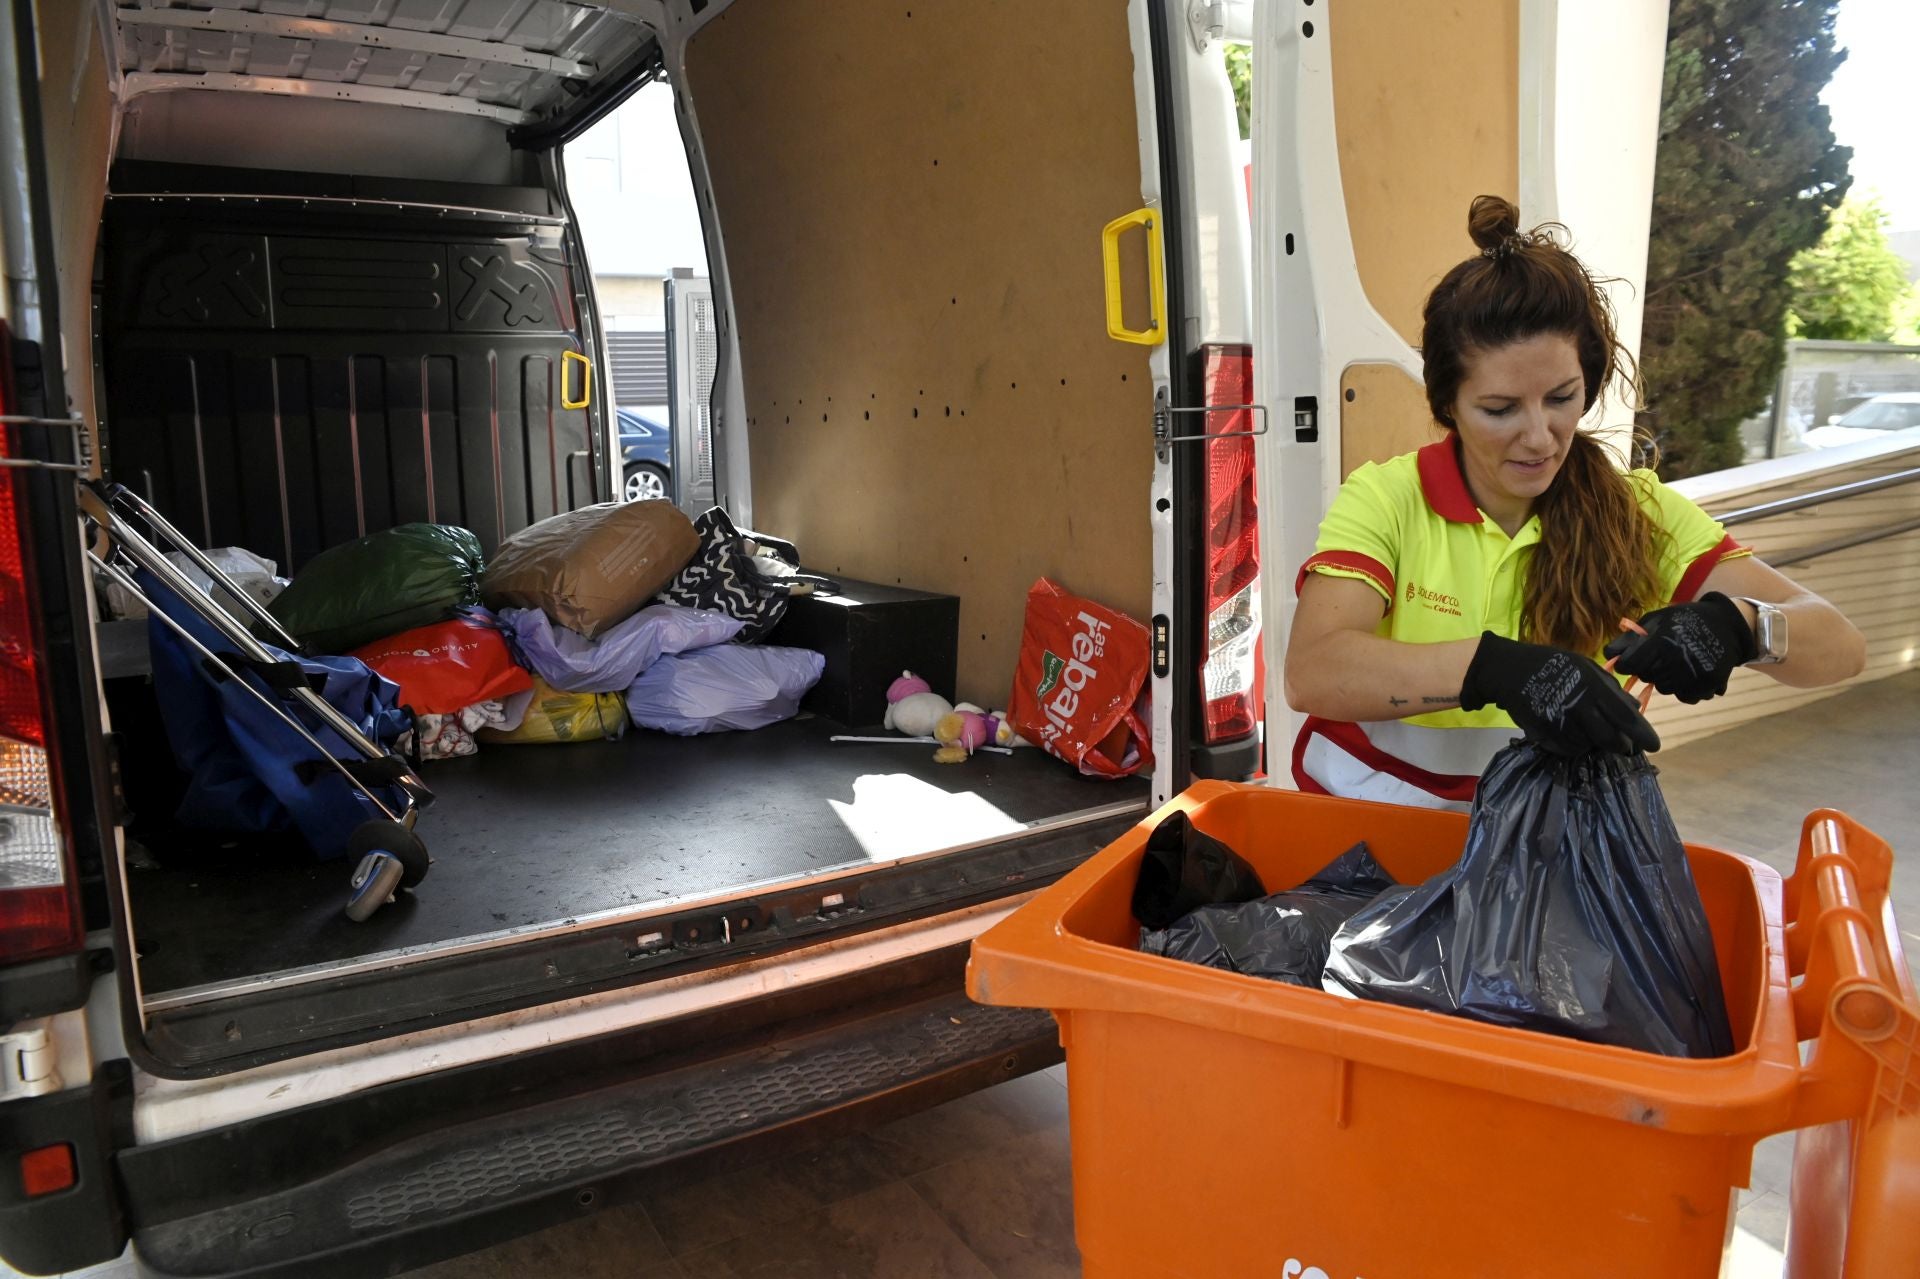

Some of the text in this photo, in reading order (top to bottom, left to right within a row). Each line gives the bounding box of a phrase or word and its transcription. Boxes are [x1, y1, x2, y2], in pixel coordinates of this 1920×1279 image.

[431, 642, 479, 654] ALVARO
[1094, 619, 1111, 658] Las
[1040, 610, 1099, 763] rebaj
